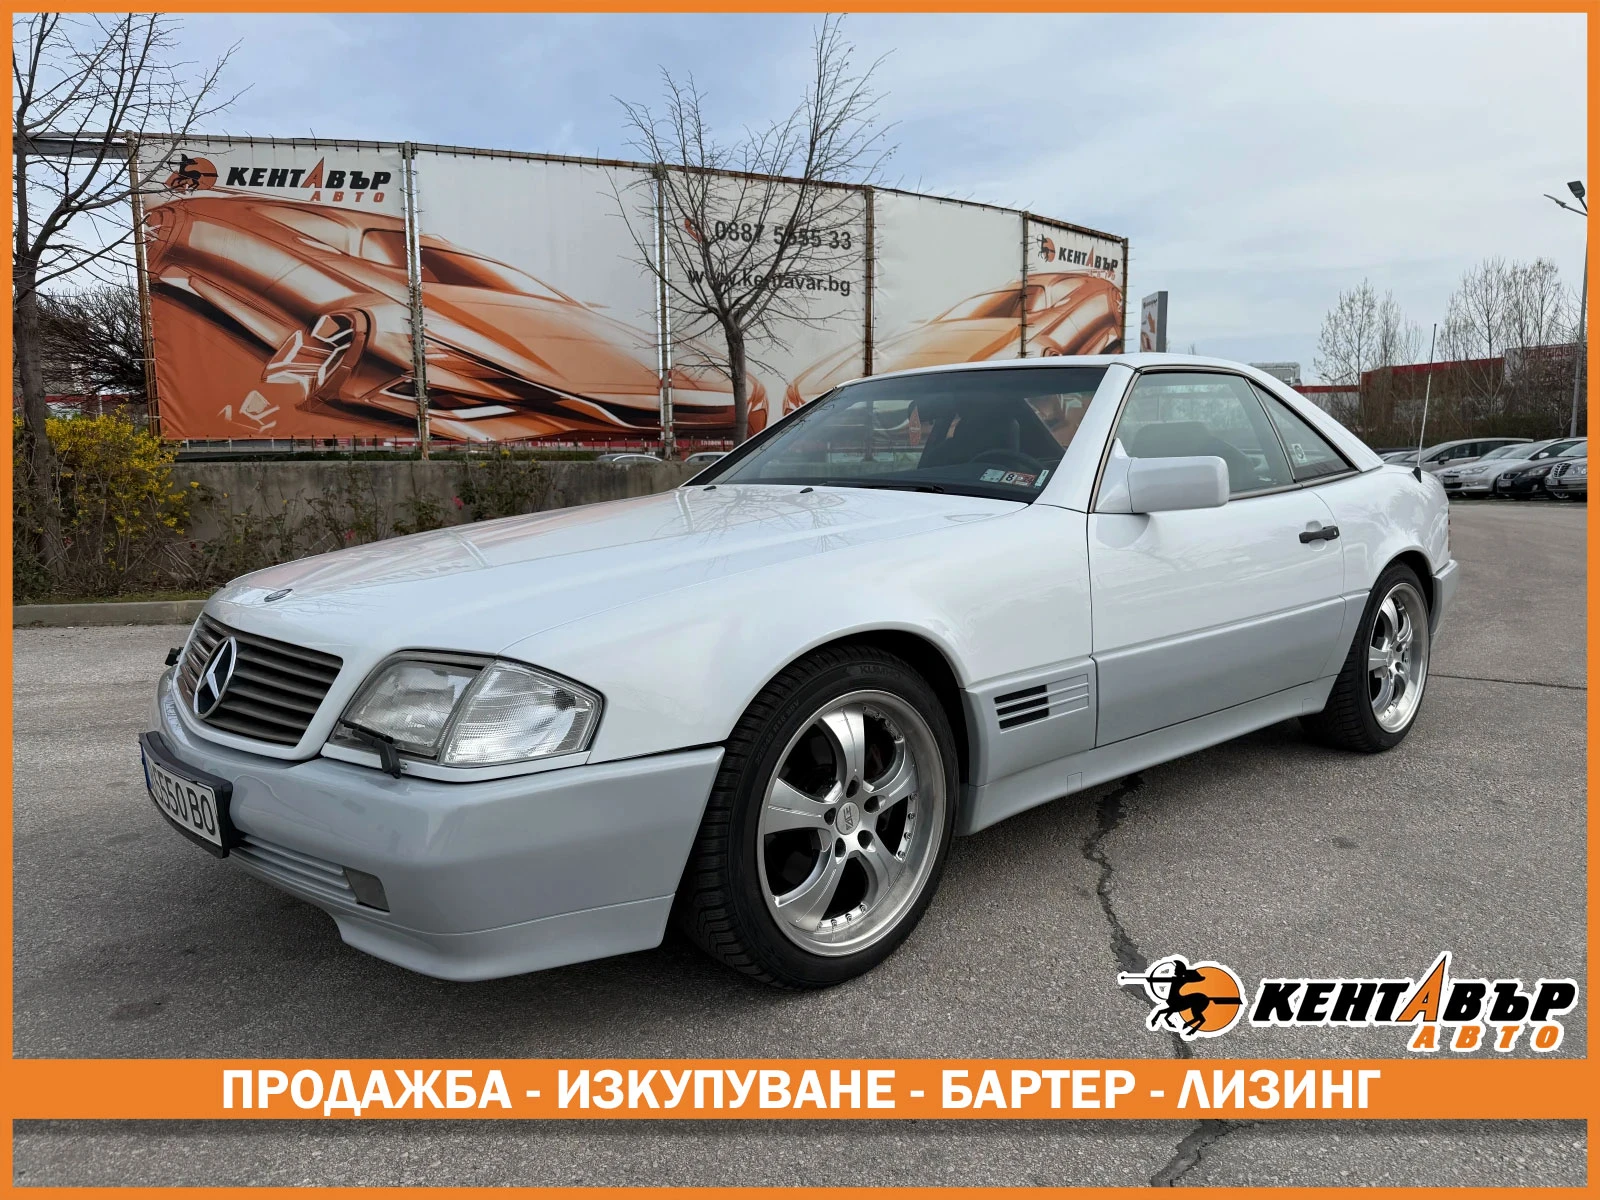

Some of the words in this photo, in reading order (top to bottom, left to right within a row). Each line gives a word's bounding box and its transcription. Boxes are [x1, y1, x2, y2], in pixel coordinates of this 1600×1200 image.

[226, 156, 392, 190] КЕНТАВЪР
[310, 191, 385, 203] АВТО
[715, 220, 765, 243] 0887
[828, 231, 852, 250] 33
[1058, 245, 1119, 271] КЕНТАВЪР
[688, 266, 851, 297] ww.ketavar.bg
